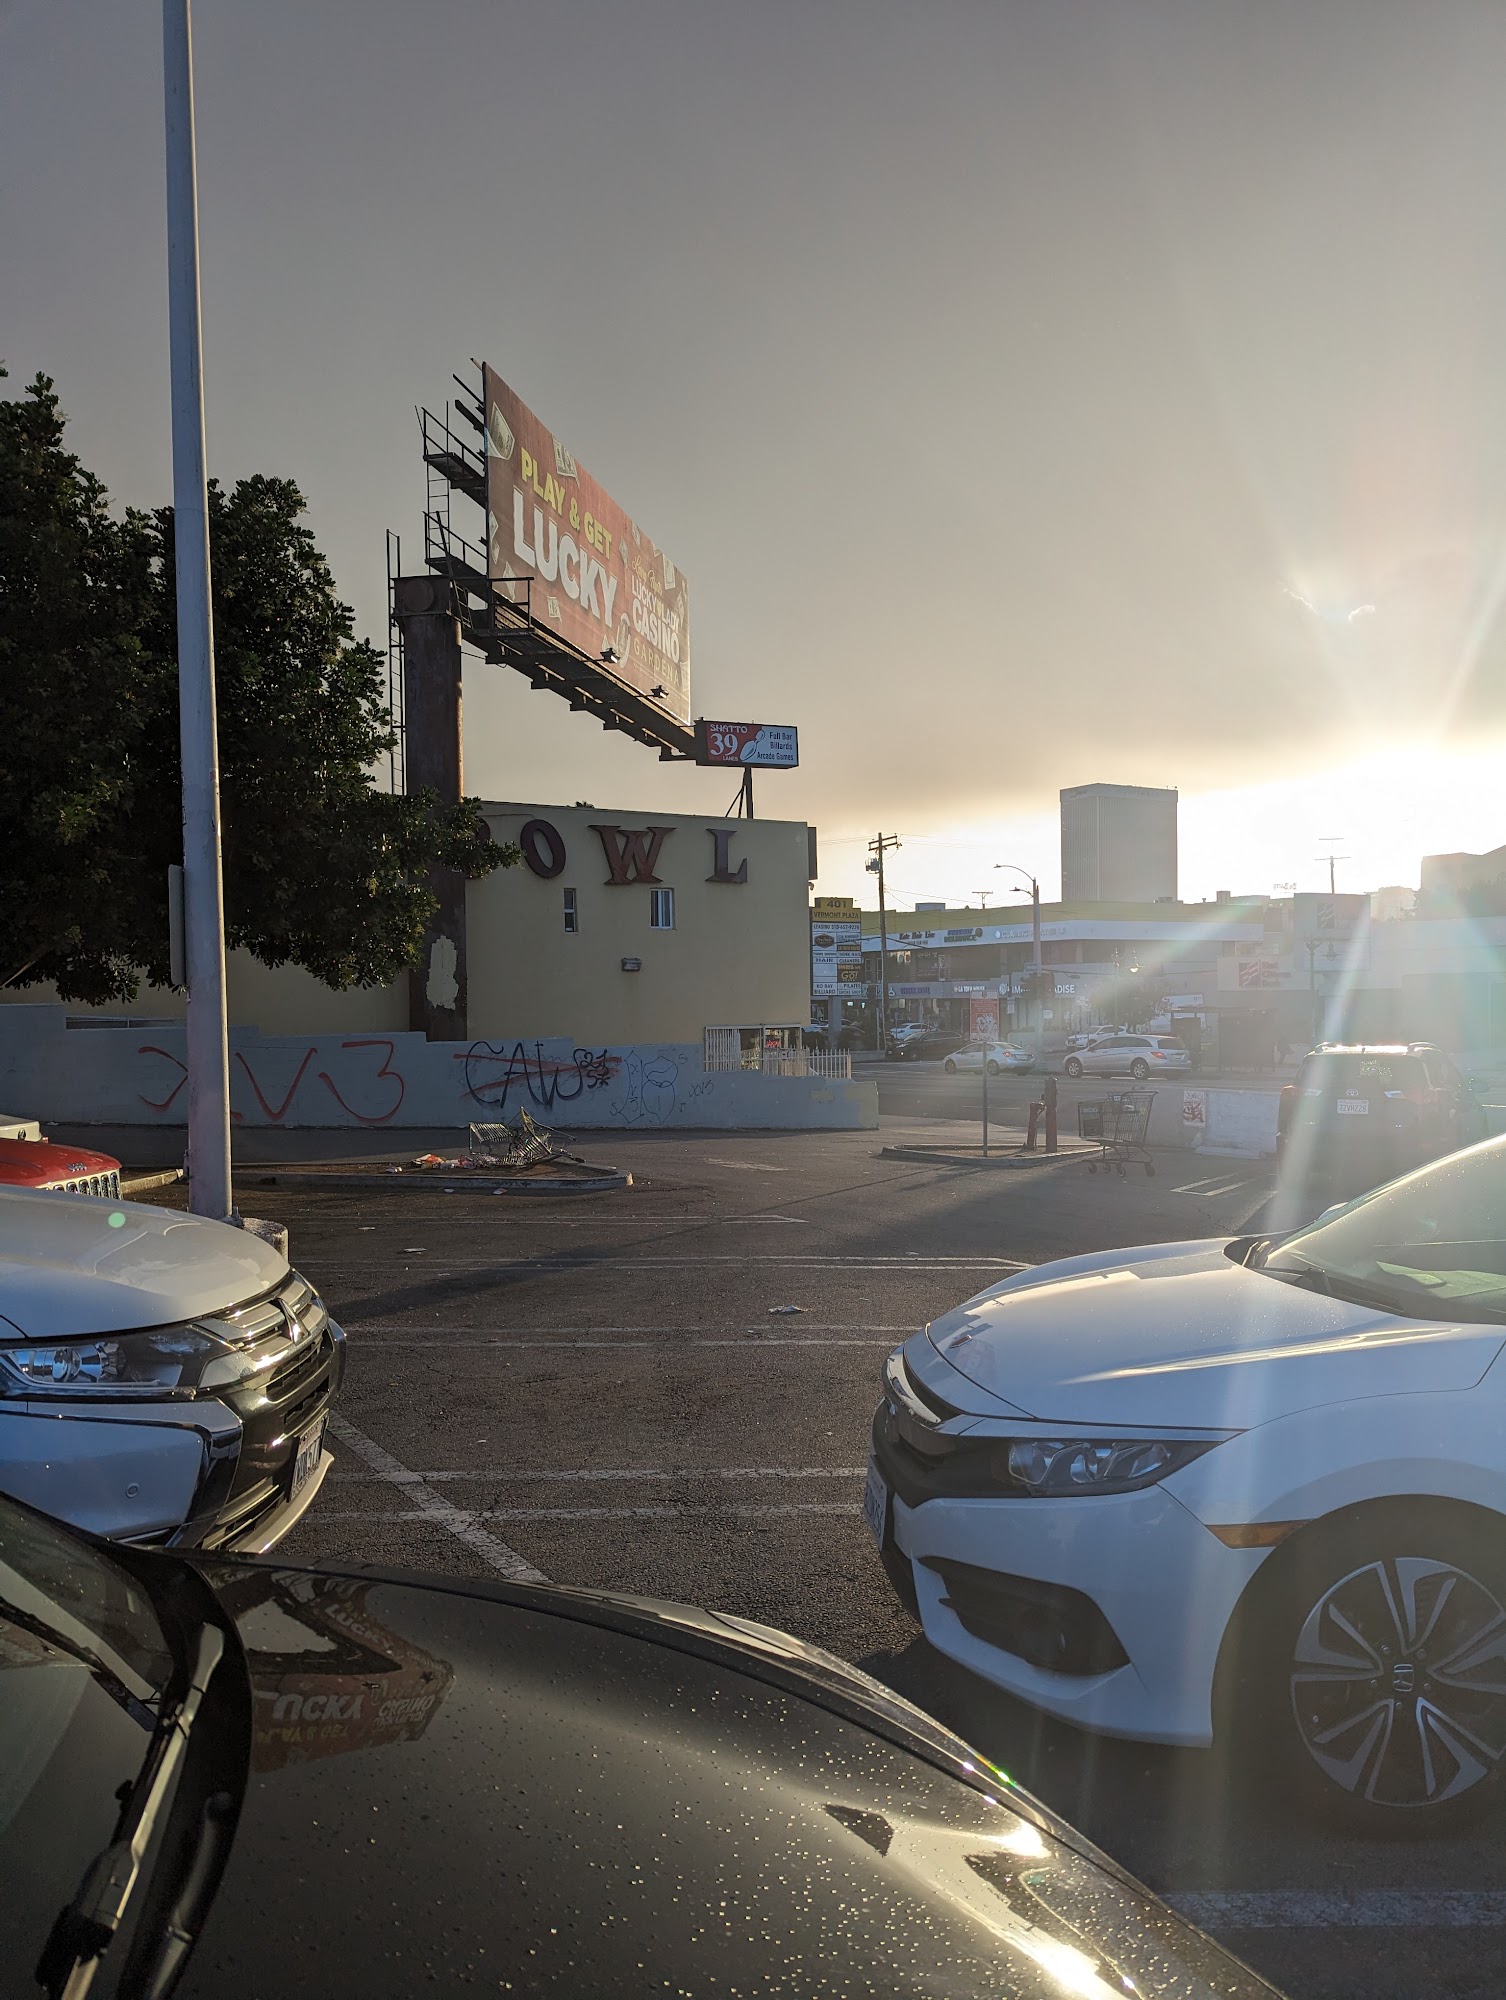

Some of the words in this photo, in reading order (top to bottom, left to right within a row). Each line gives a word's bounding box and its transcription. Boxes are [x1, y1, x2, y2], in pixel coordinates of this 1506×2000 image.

[521, 447, 565, 516] PLAY
[569, 497, 580, 531] &
[584, 511, 612, 560] GET
[513, 485, 617, 628] LUCKY
[632, 575, 657, 613] LUCKY
[661, 602, 680, 634] LADY
[632, 598, 680, 663] CASINO
[634, 637, 680, 687] GARDENA
[710, 724, 748, 734] SHATTO
[710, 733, 738, 756] 39
[769, 731, 781, 740] Full
[781, 732, 793, 741] Bar
[757, 752, 775, 760] Arcade
[776, 752, 794, 761] Games
[826, 900, 847, 908] 401
